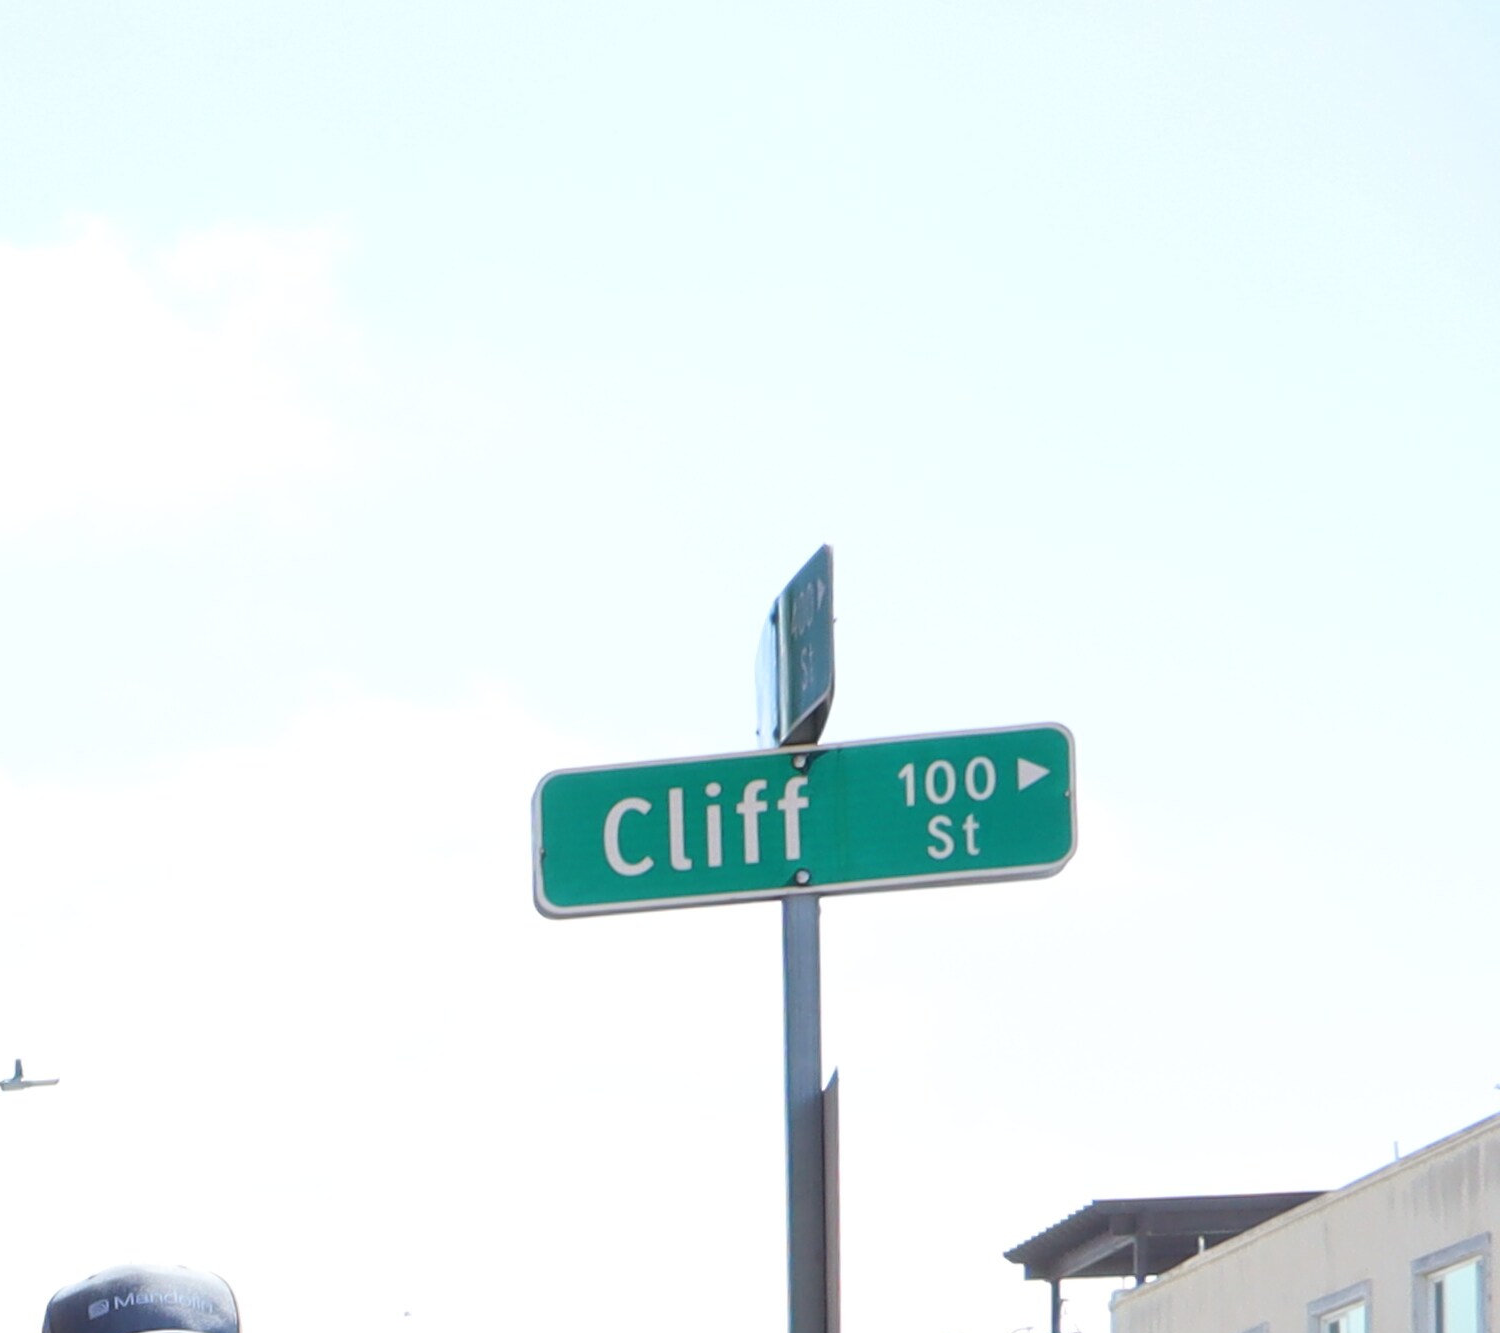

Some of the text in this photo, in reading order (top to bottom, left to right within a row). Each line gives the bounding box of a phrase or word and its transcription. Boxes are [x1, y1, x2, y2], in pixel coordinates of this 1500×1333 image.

[603, 756, 997, 877] Cliff 100
[927, 812, 981, 860] St
